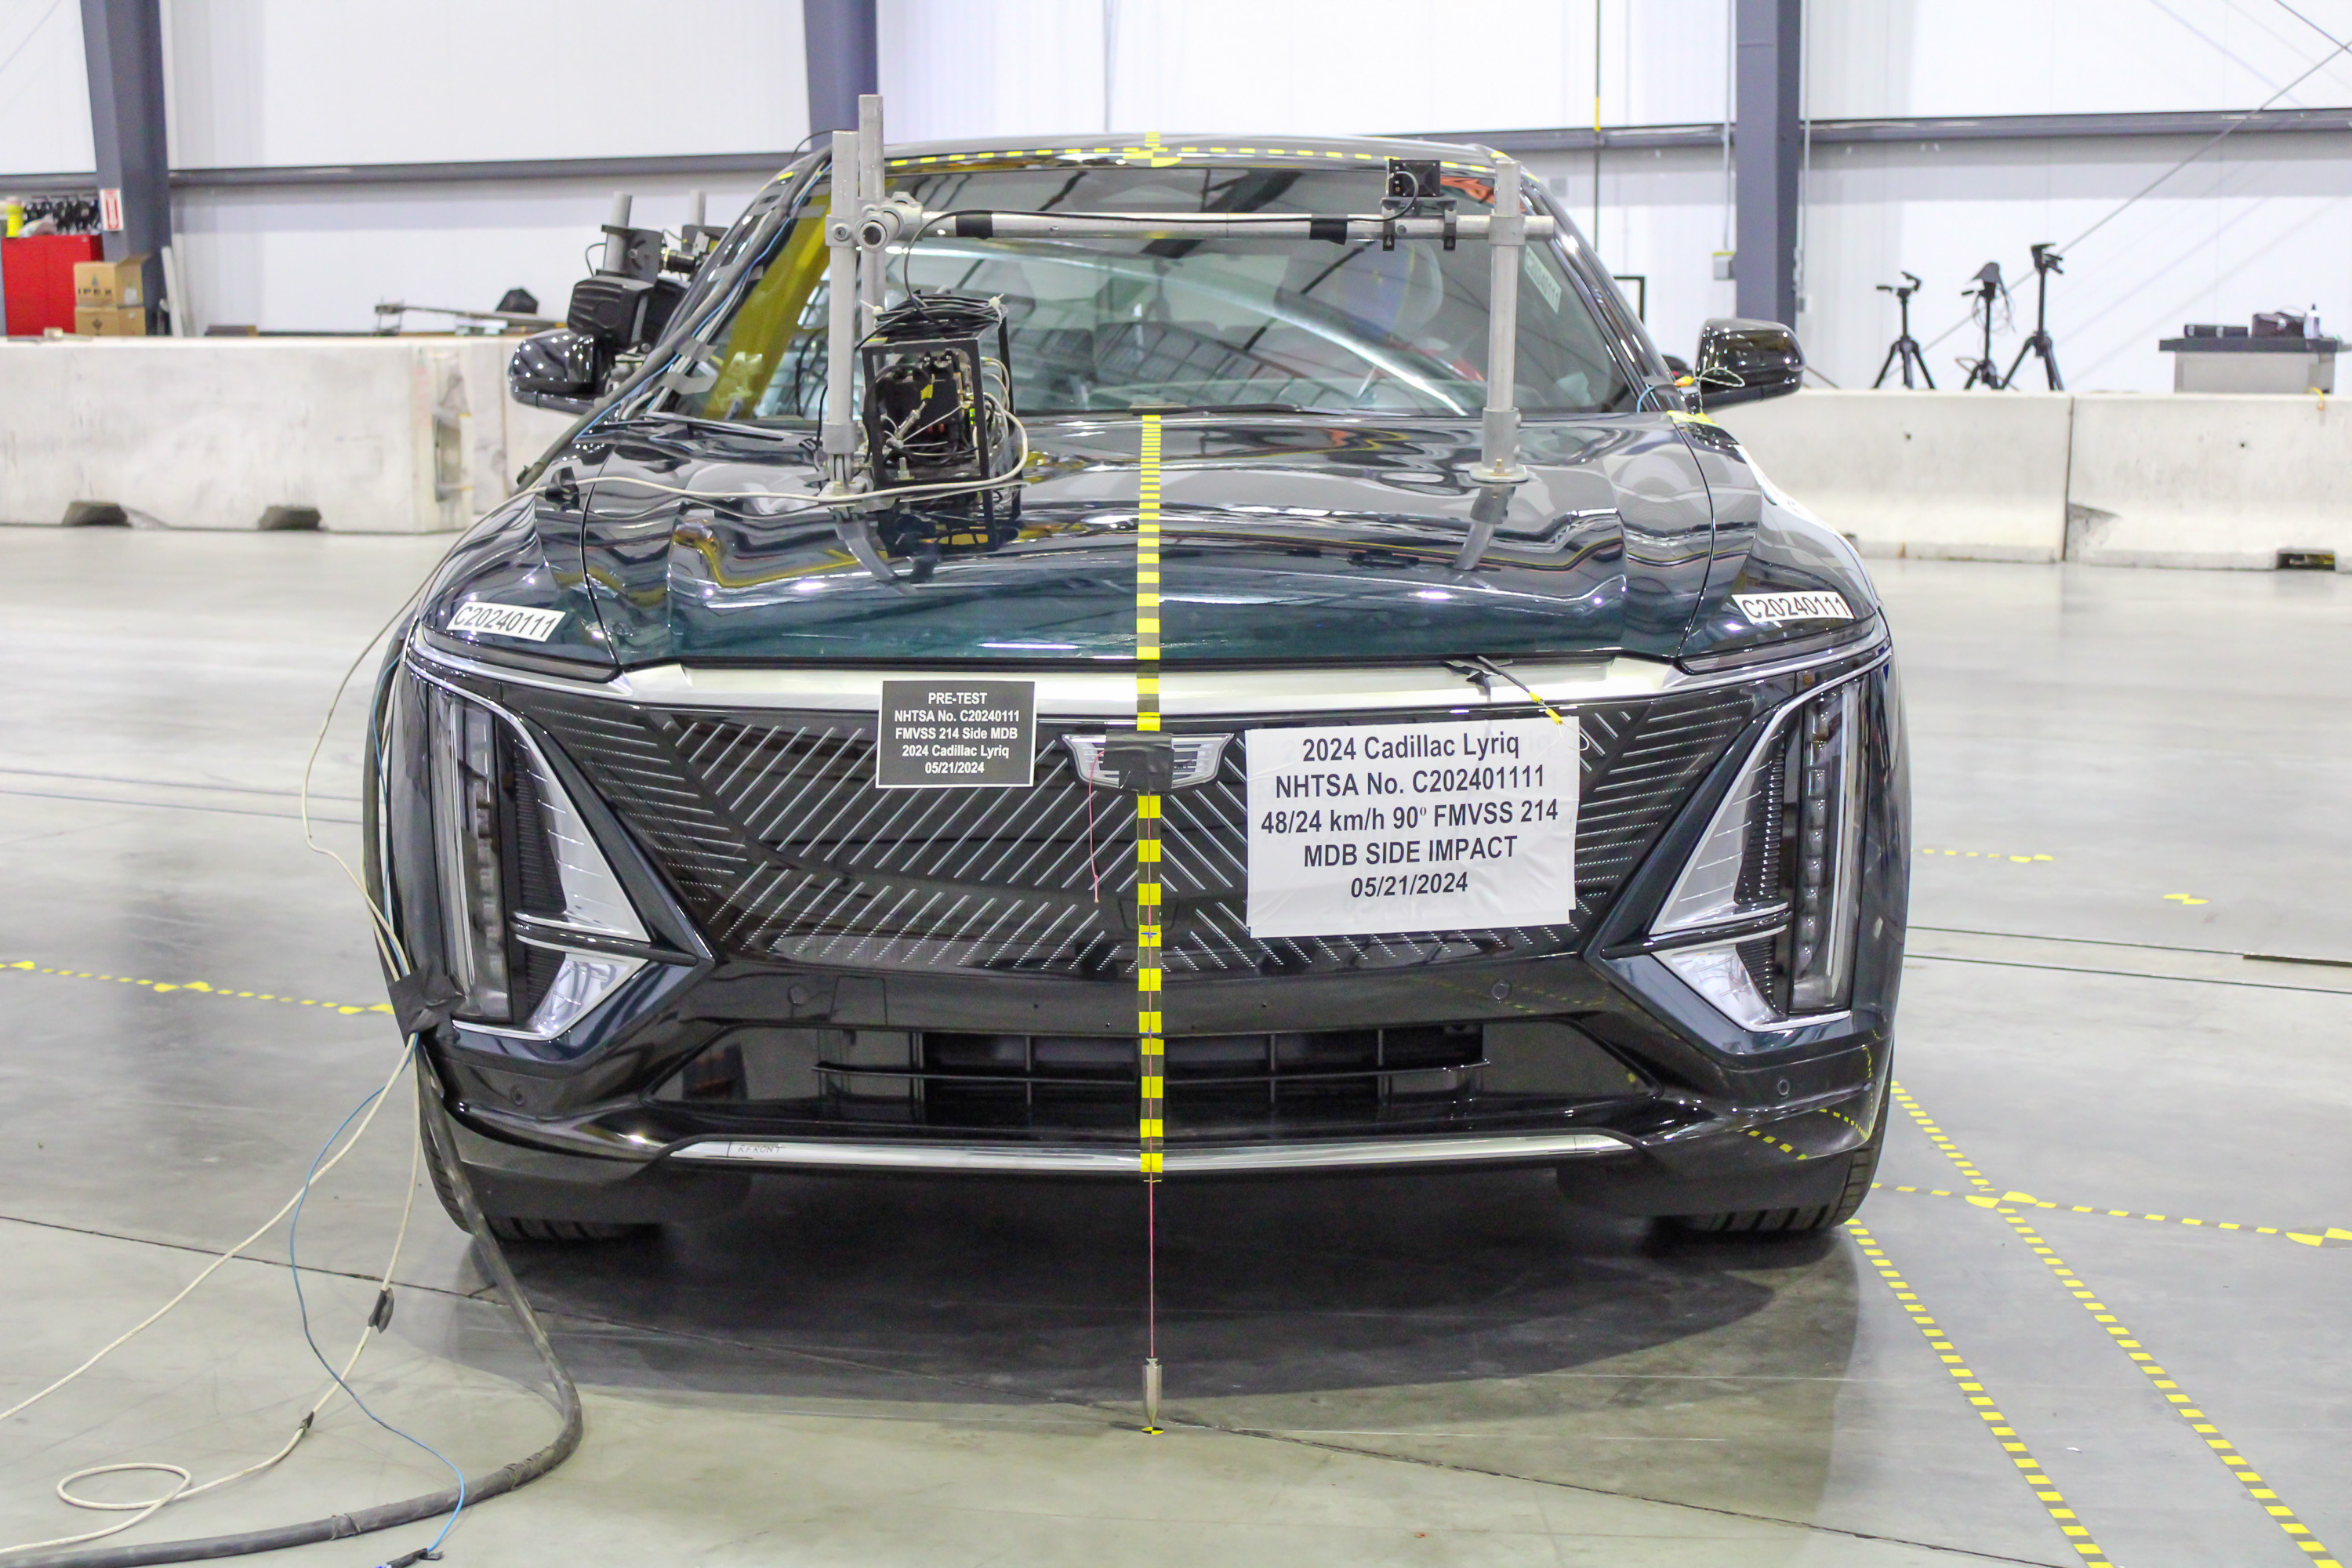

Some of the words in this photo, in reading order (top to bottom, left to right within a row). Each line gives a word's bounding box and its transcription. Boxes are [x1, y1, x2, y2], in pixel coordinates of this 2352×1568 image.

[1742, 596, 1849, 619] C20240111
[453, 606, 557, 638] C20240111
[927, 691, 988, 705] PRE-TEST
[894, 710, 936, 723] NHTSA
[938, 710, 957, 722] No.
[960, 709, 1019, 722] C20240111
[895, 727, 937, 740] FMVSS
[938, 727, 960, 739] 214
[962, 727, 988, 739] Side
[990, 727, 1018, 739] MDB
[1302, 737, 1356, 762] 2024
[1364, 734, 1456, 760] Cadillac
[1463, 730, 1519, 761] Lyriq
[902, 744, 930, 757] 2024
[931, 744, 978, 757] Cadillac
[980, 744, 1010, 760] Lyriq
[924, 761, 985, 774] 05/21/2024
[1276, 773, 1359, 799] NHTSA
[1367, 771, 1404, 796] No.
[1412, 764, 1544, 793] C202401111
[1261, 809, 1322, 834] 48/24
[1330, 807, 1385, 832] km/h
[1434, 800, 1513, 827] FMVSS
[1520, 798, 1559, 822] 214
[1304, 843, 1358, 868] MDB
[1366, 840, 1421, 866] SIDE
[1428, 835, 1518, 862] IMPACT
[1351, 871, 1468, 898] 05/21/2024
